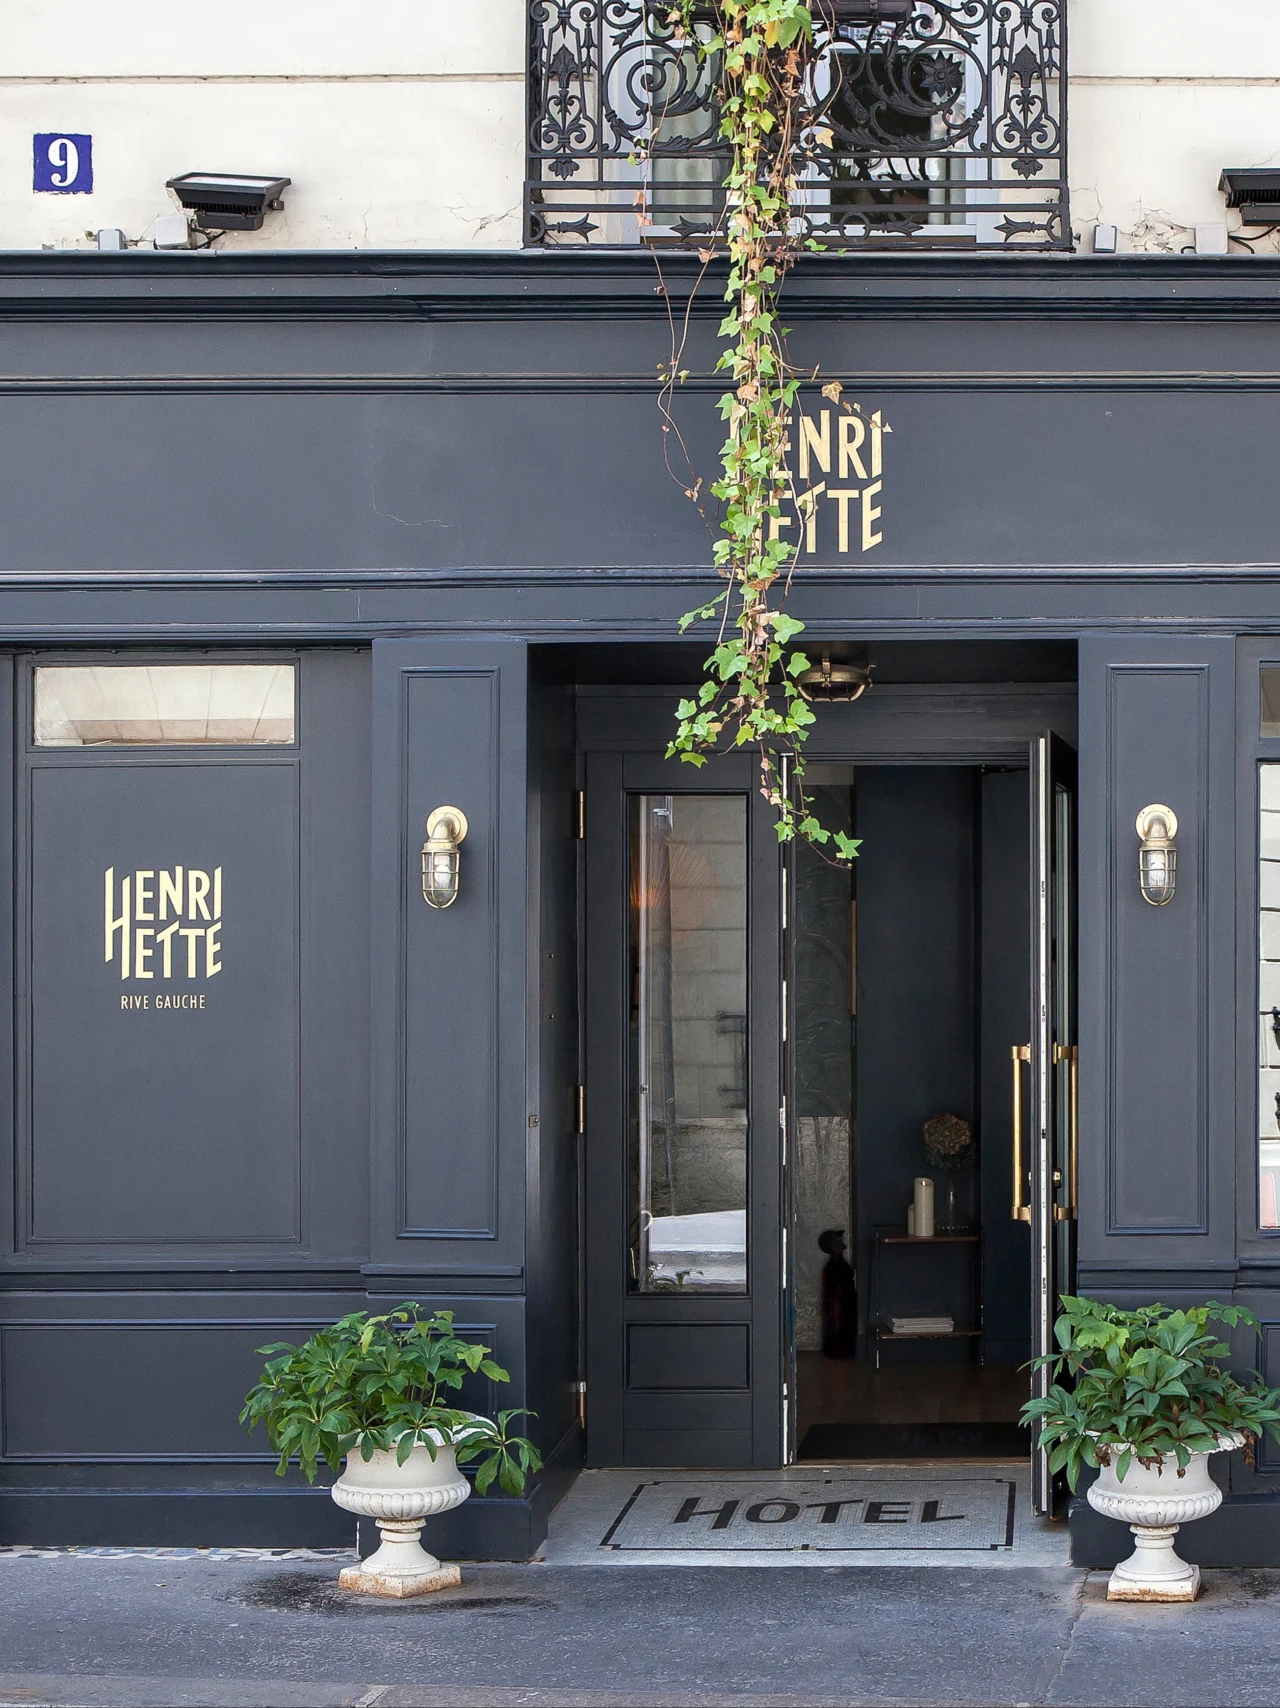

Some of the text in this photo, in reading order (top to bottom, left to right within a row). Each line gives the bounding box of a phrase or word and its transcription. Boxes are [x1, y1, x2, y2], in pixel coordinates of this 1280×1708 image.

[47, 138, 79, 187] 9
[121, 994, 206, 1009] RIVE GAUCHE
[672, 1497, 966, 1530] HÔTEL
